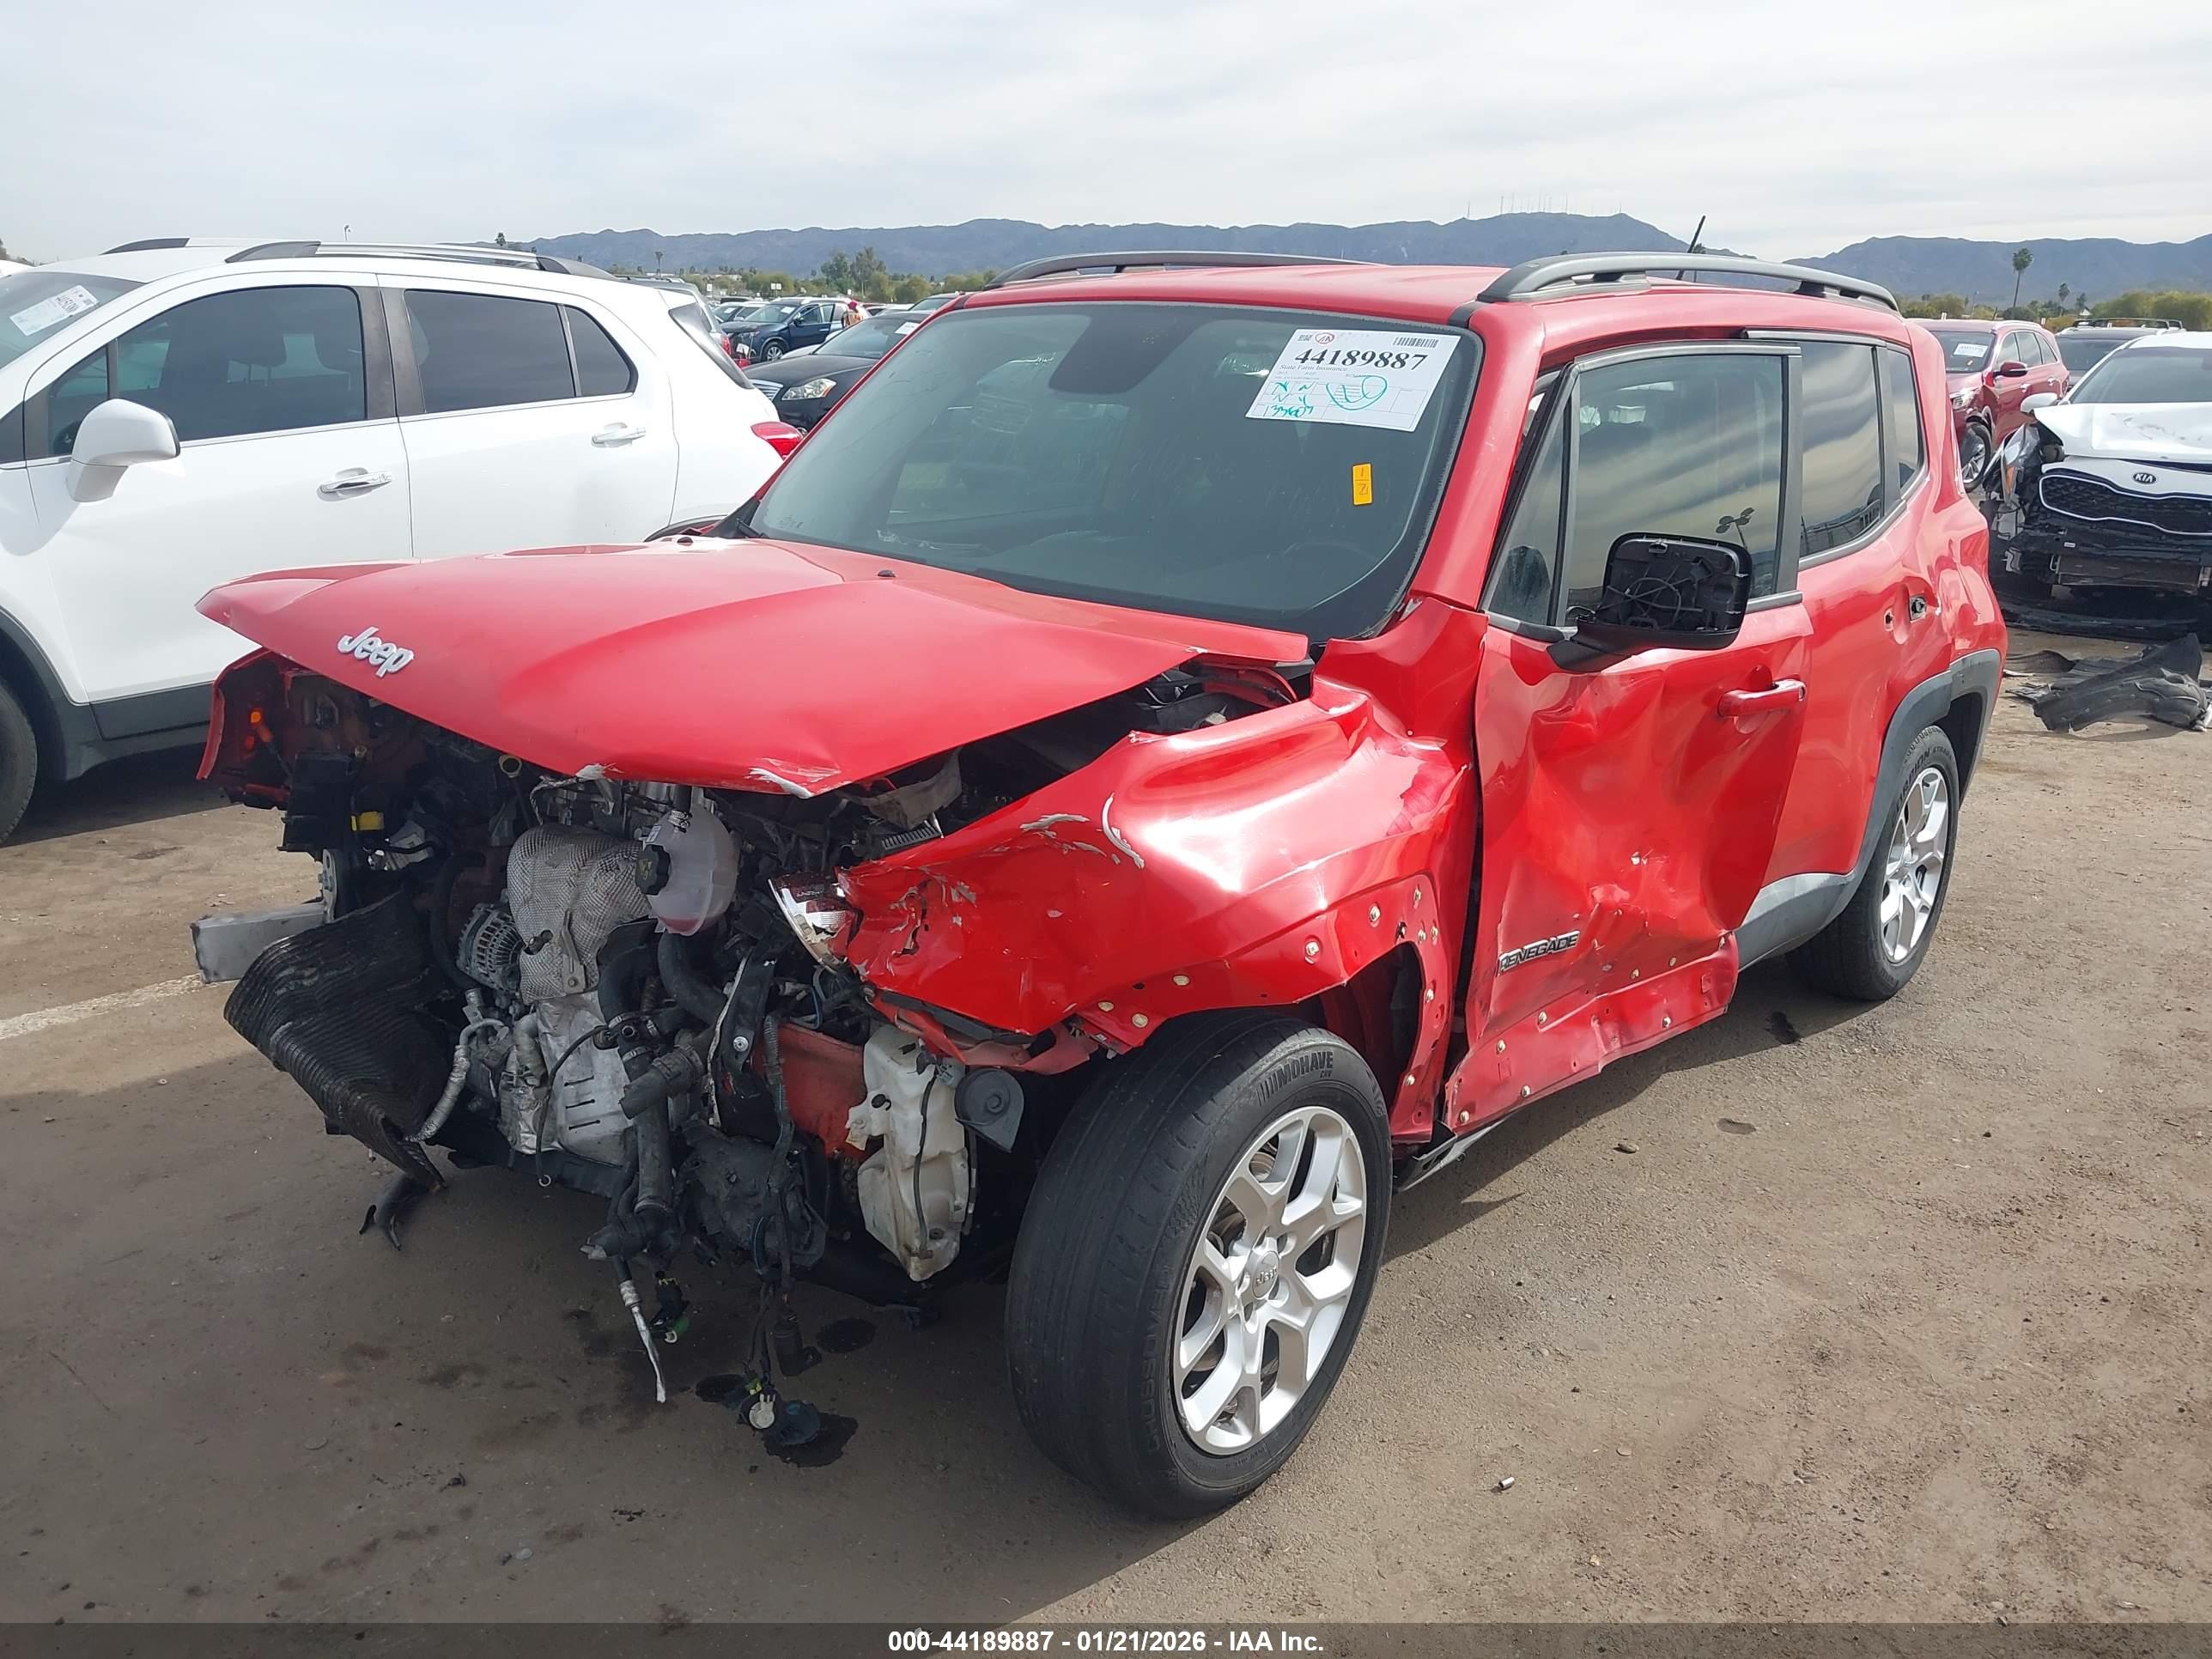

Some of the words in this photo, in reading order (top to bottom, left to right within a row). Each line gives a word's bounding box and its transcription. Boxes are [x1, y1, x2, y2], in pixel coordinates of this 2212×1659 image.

[1295, 348, 1428, 370] 44189887
[2135, 473, 2153, 482] KIA
[337, 626, 415, 678] Jeep
[1498, 930, 1580, 975] RENEGADE
[1277, 1050, 1333, 1090] MOHAVE
